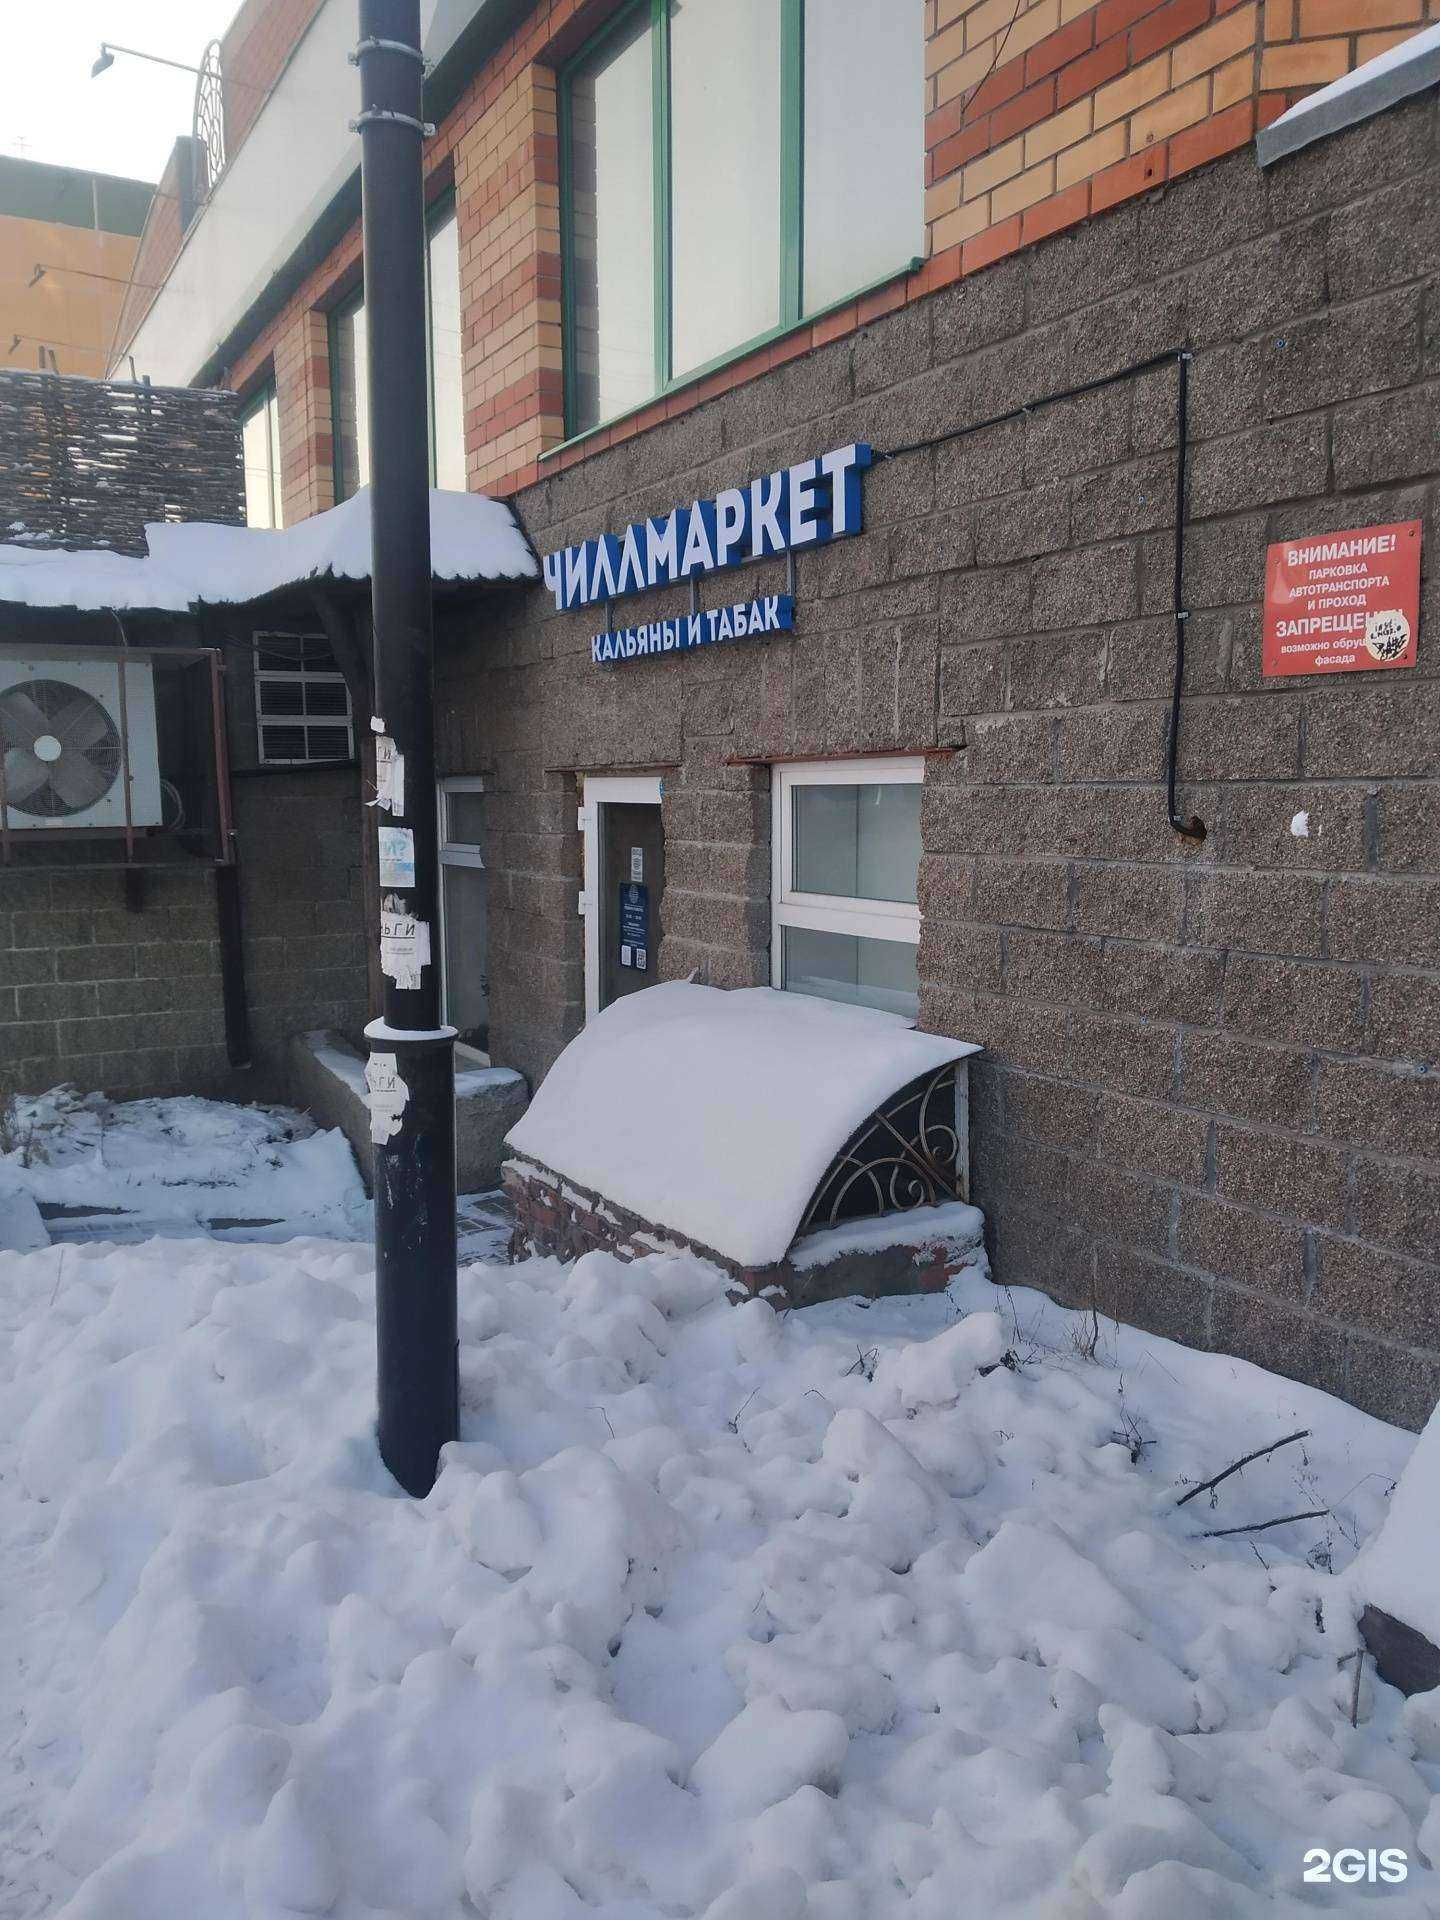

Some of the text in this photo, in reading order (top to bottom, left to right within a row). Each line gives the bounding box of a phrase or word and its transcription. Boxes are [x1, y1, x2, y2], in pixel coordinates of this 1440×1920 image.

[543, 443, 857, 610] ЧИЛЛМАРКЕТ
[1287, 534, 1396, 567] ВНИМАНИЕ!
[1308, 562, 1368, 580] ПАРКОВКА
[1289, 575, 1390, 598] АВТОТРАНСПОРТА
[1307, 594, 1367, 611] И ПРОХОД
[591, 595, 781, 662] КАЛЬЯНЫ И ТАБАК
[1276, 609, 1403, 638] ЗАПРЕЩЕ
[1281, 641, 1330, 654] возможно
[1315, 654, 1356, 667] фасада
